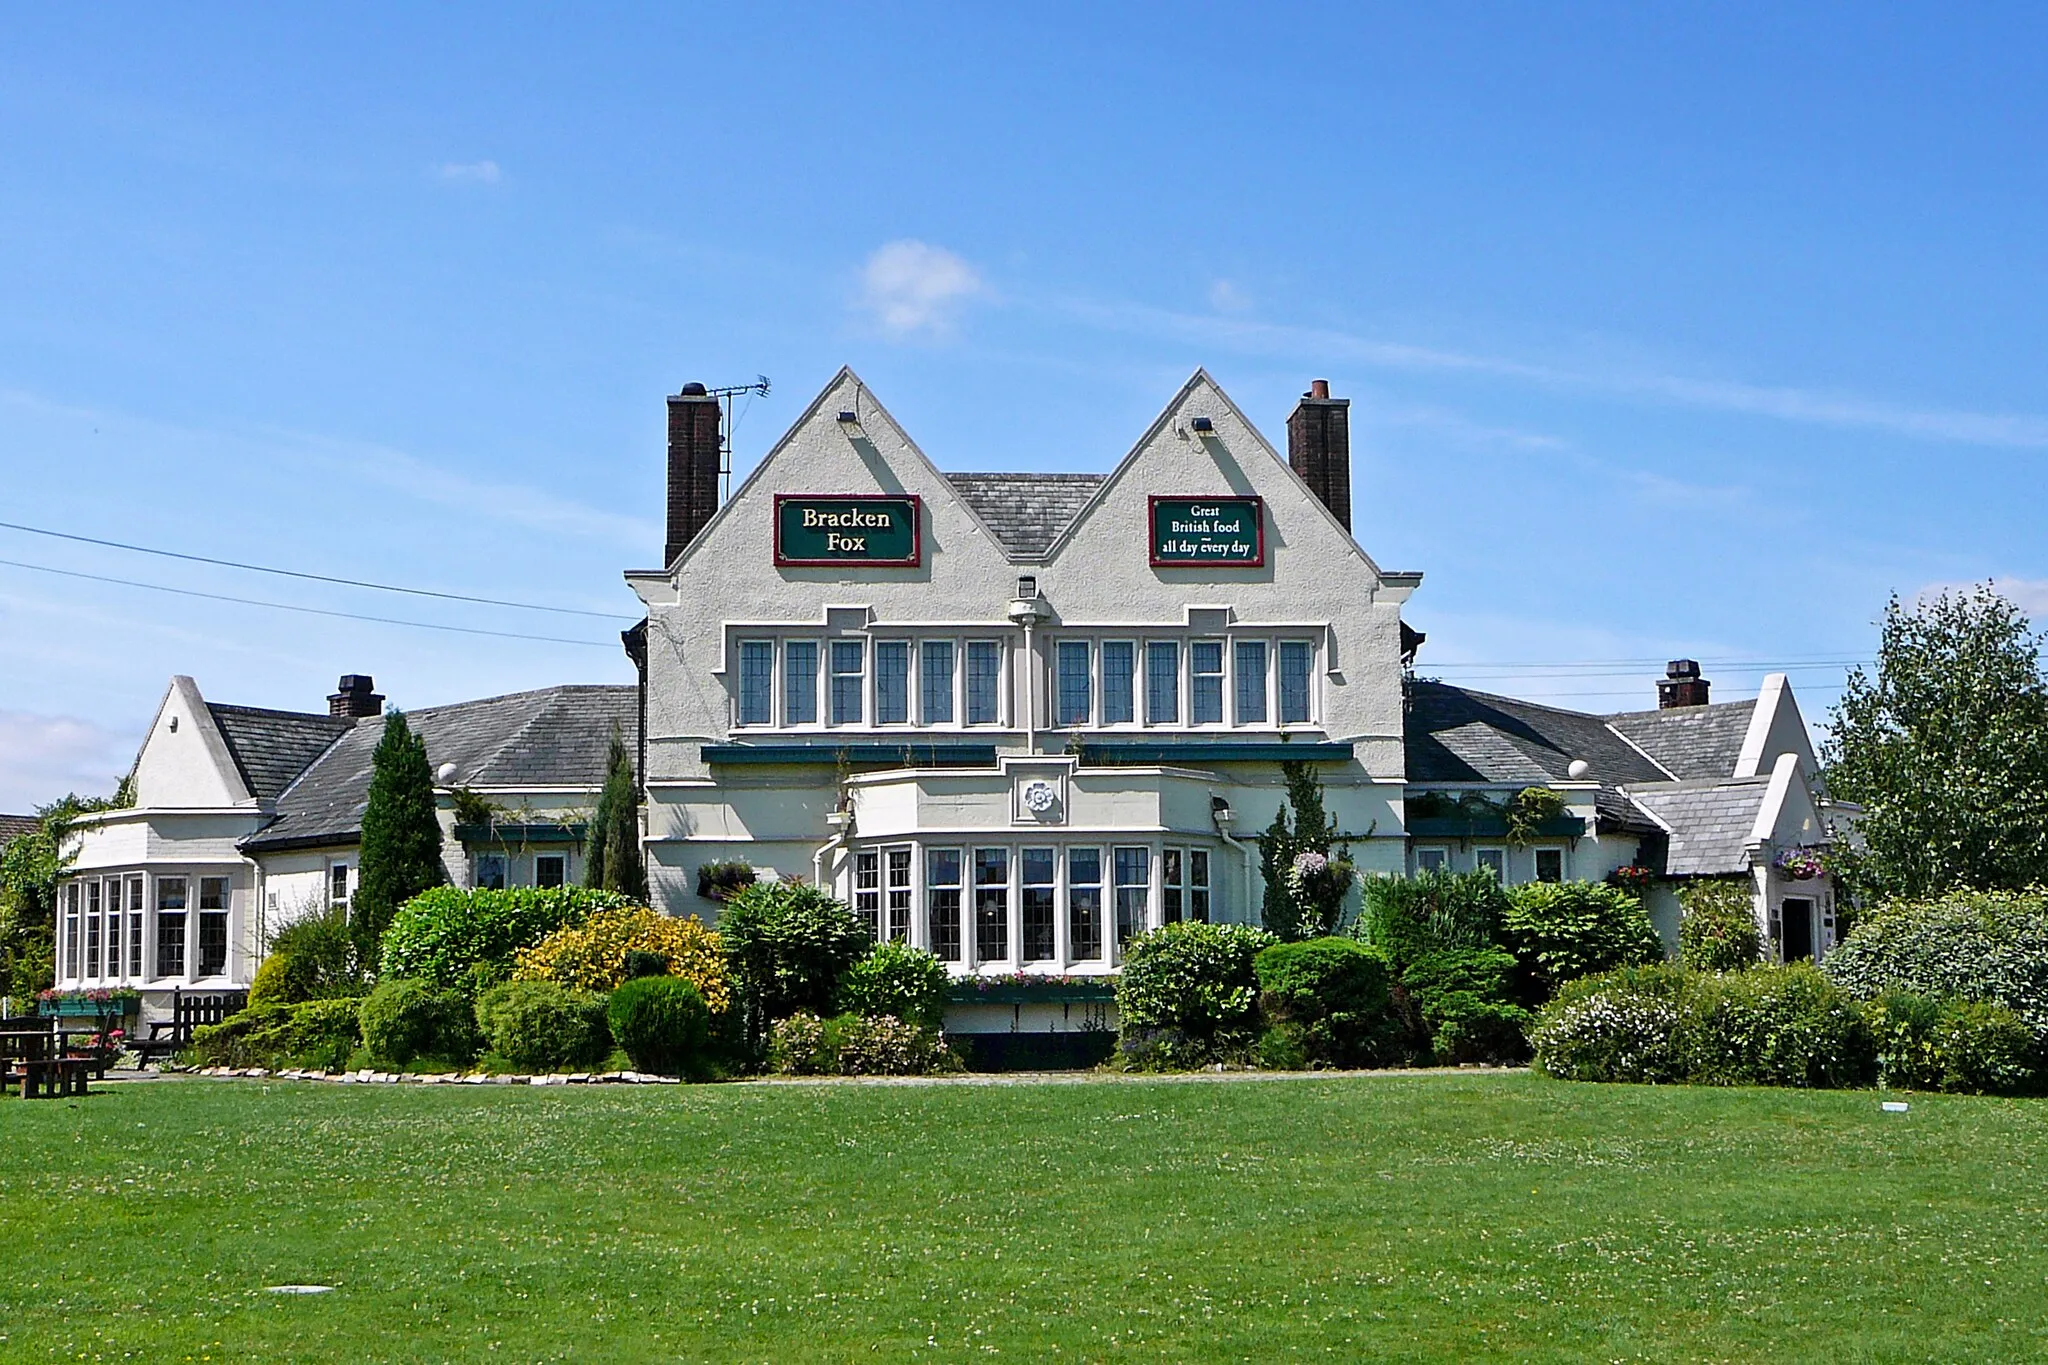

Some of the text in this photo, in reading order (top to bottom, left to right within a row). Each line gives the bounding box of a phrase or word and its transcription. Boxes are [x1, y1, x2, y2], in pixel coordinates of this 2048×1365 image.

[802, 508, 891, 527] Bracken
[1190, 505, 1220, 516] Great
[1171, 520, 1240, 532] British food
[827, 533, 866, 551] Fox
[1162, 540, 1250, 557] all day every day
